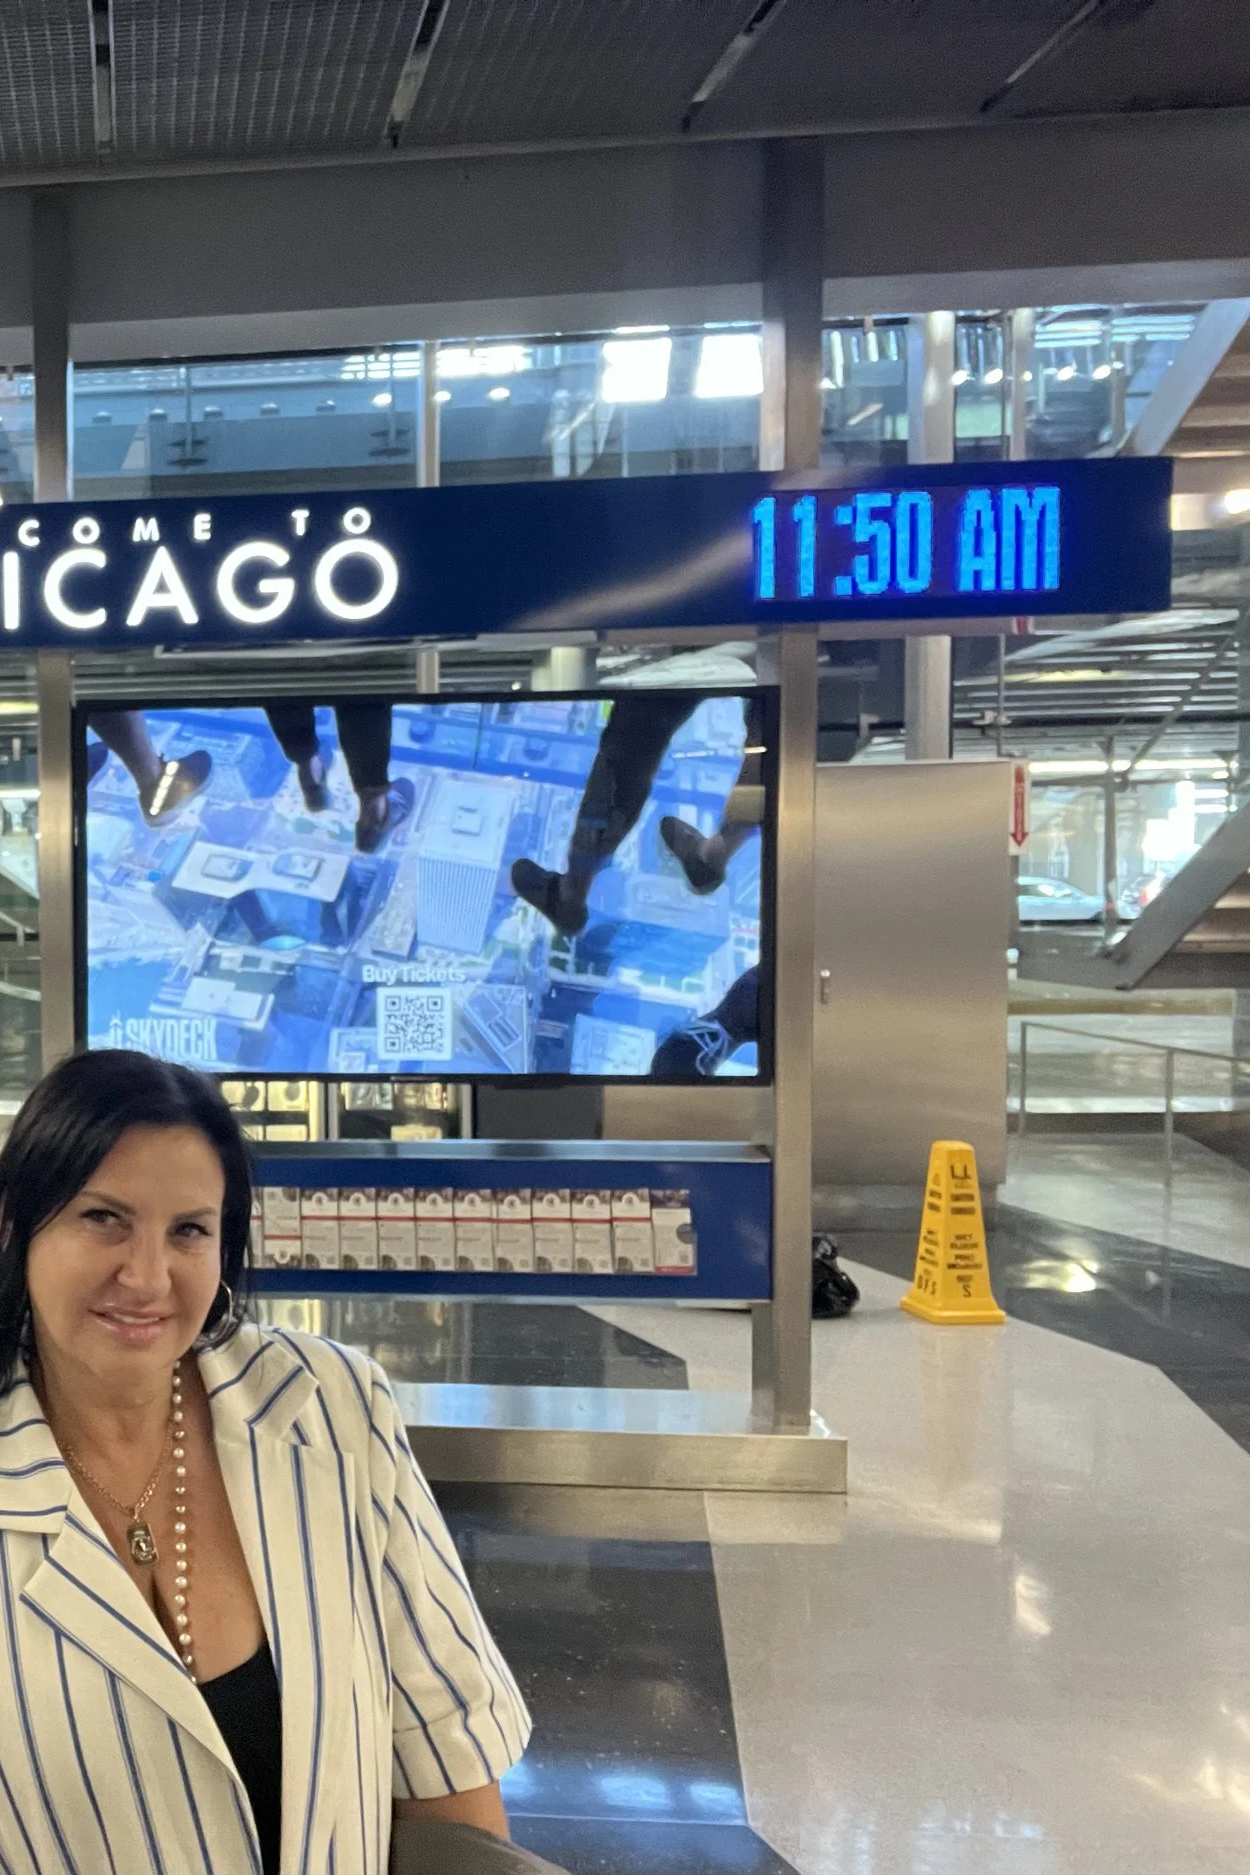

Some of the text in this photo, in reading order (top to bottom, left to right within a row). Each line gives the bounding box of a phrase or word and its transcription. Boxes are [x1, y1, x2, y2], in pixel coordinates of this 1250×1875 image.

[290, 506, 372, 536] TO
[751, 486, 1061, 600] 11:50 AM
[362, 964, 467, 986] Buy Tickets
[125, 1019, 218, 1060] SKYDECK
